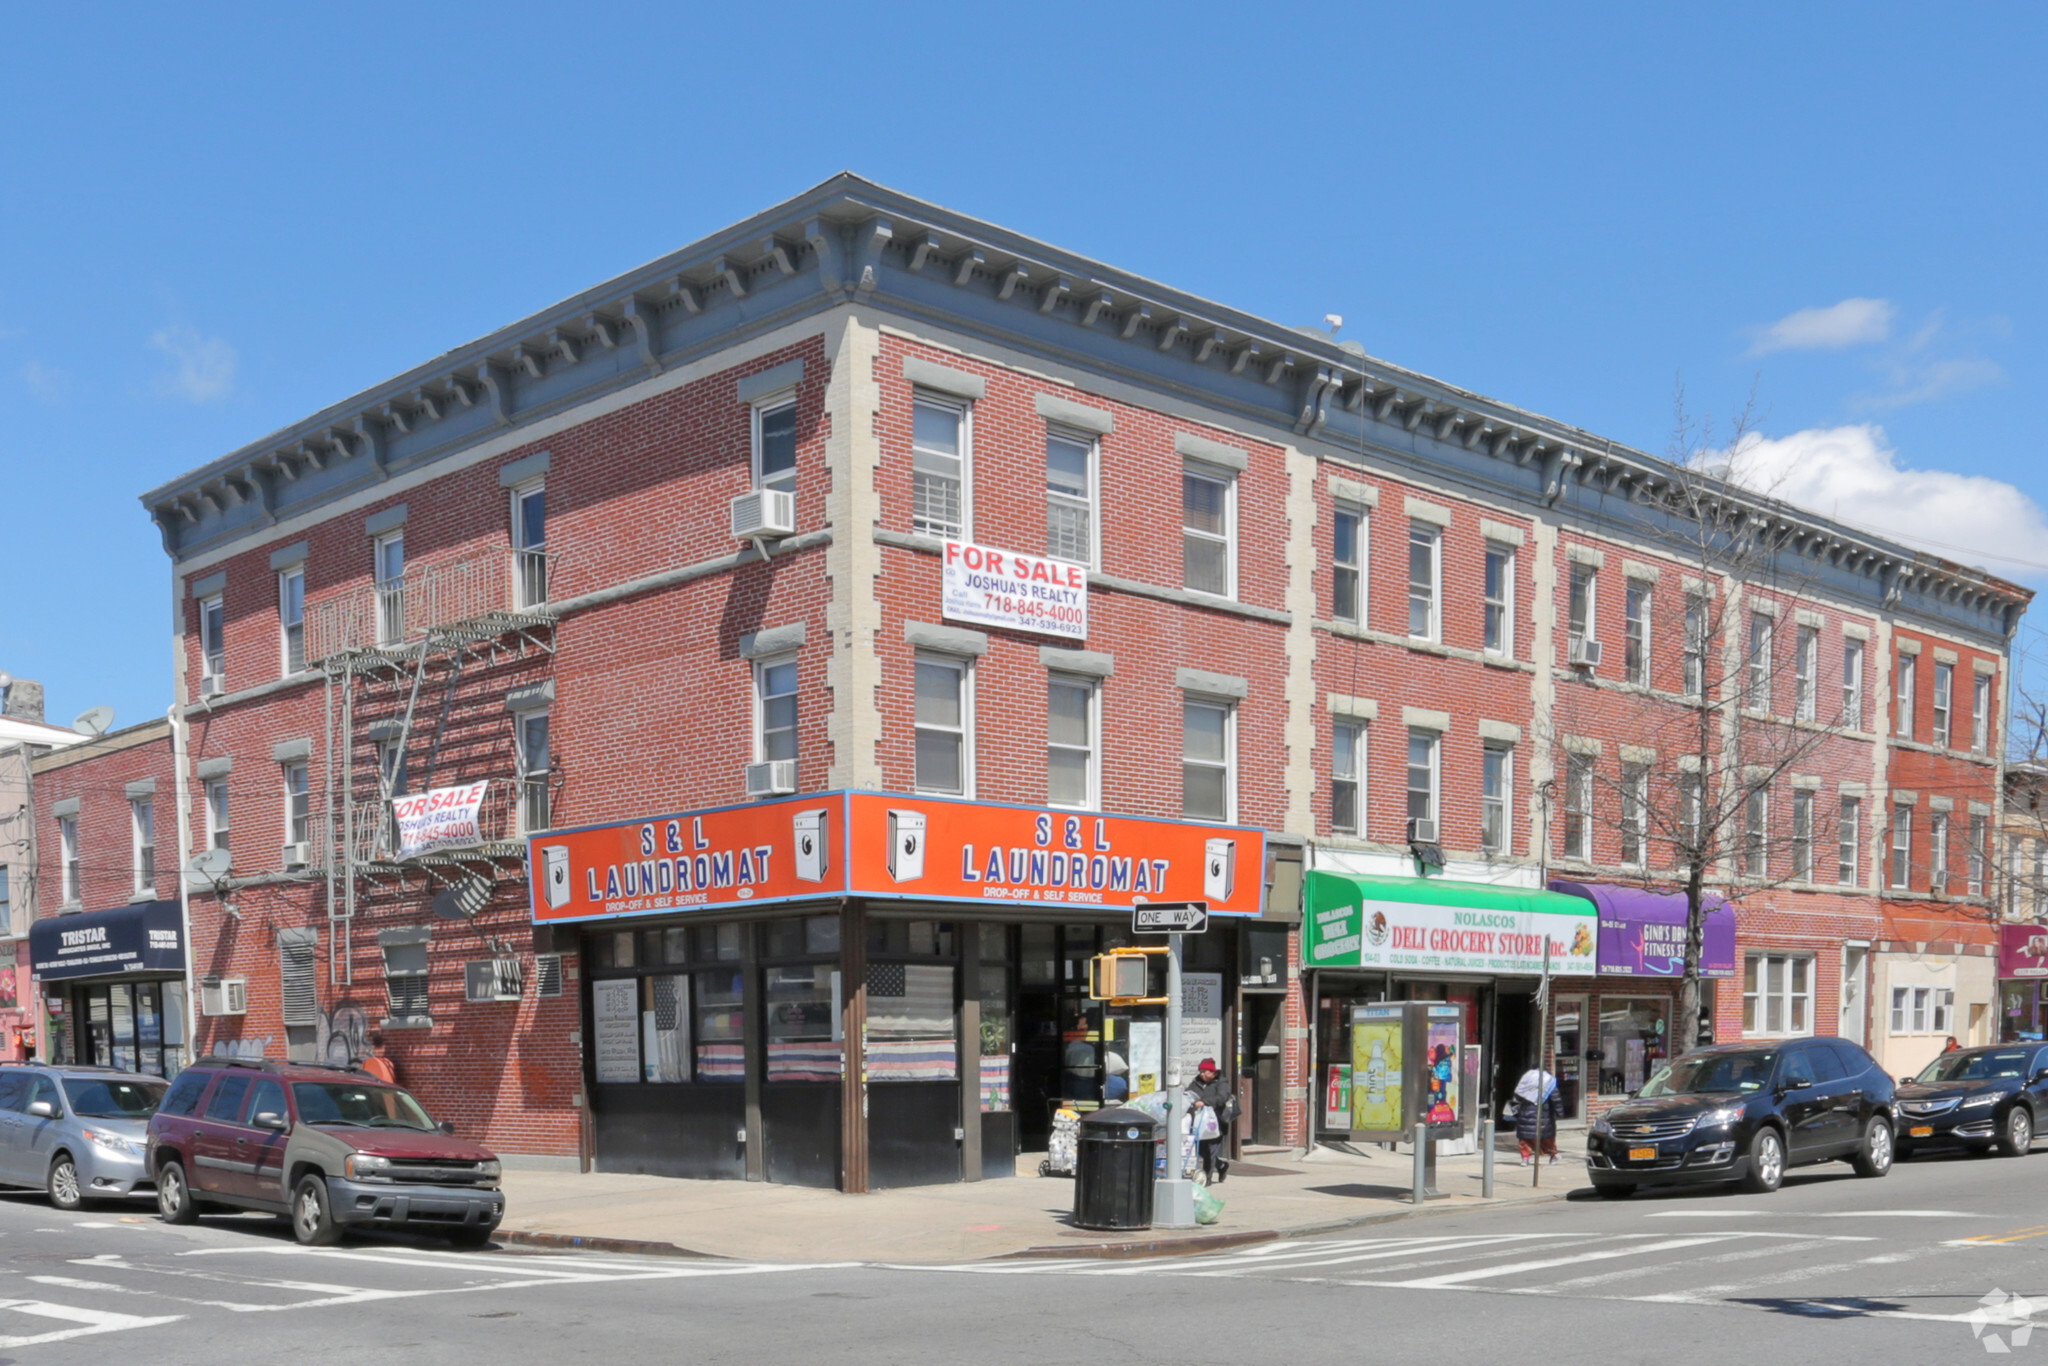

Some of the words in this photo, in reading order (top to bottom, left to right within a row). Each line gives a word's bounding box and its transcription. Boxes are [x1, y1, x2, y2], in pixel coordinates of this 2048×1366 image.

[946, 543, 1003, 575] FOR
[1014, 557, 1082, 589] SALE
[965, 573, 1028, 597] JOSHUA'S
[1032, 585, 1078, 605] REALTY
[984, 593, 1083, 624] 718-845-4000
[1019, 616, 1082, 635] 347-539-6923
[429, 785, 482, 812] SALE
[434, 807, 470, 823] REALTY
[640, 823, 655, 856] S
[666, 819, 683, 853] &
[693, 816, 710, 850] L
[1035, 813, 1053, 846] S
[1064, 816, 1083, 849] &
[1095, 818, 1112, 852] L
[587, 845, 773, 902] LAUNDROMAT
[961, 844, 1170, 894] LAUNDROMAT
[605, 898, 643, 912] DROP-OFF
[645, 900, 651, 908] &
[654, 896, 673, 907] SELF
[675, 893, 708, 906] SERVICE
[983, 887, 1031, 899] DROP-OFF
[1033, 890, 1040, 900] &
[1043, 890, 1065, 901] SELF
[1068, 892, 1103, 903] SERVICE
[1140, 911, 1162, 924] ONE
[1173, 911, 1197, 923] WAY
[1454, 911, 1516, 929] NOLASCOS
[61, 926, 106, 947] TRISTAR
[149, 930, 177, 941] TRISTAR
[1391, 925, 1426, 950] DELI
[1430, 928, 1496, 954] GROCERY
[1498, 932, 1542, 956] STORE
[1547, 940, 1567, 957] nc.
[1643, 924, 1670, 942] GINA'S
[1644, 942, 1675, 957] FITNESS
[1421, 955, 1440, 966] COFFEE
[1366, 1008, 1390, 1017] TITAN
[1368, 1068, 1376, 1094] hint
